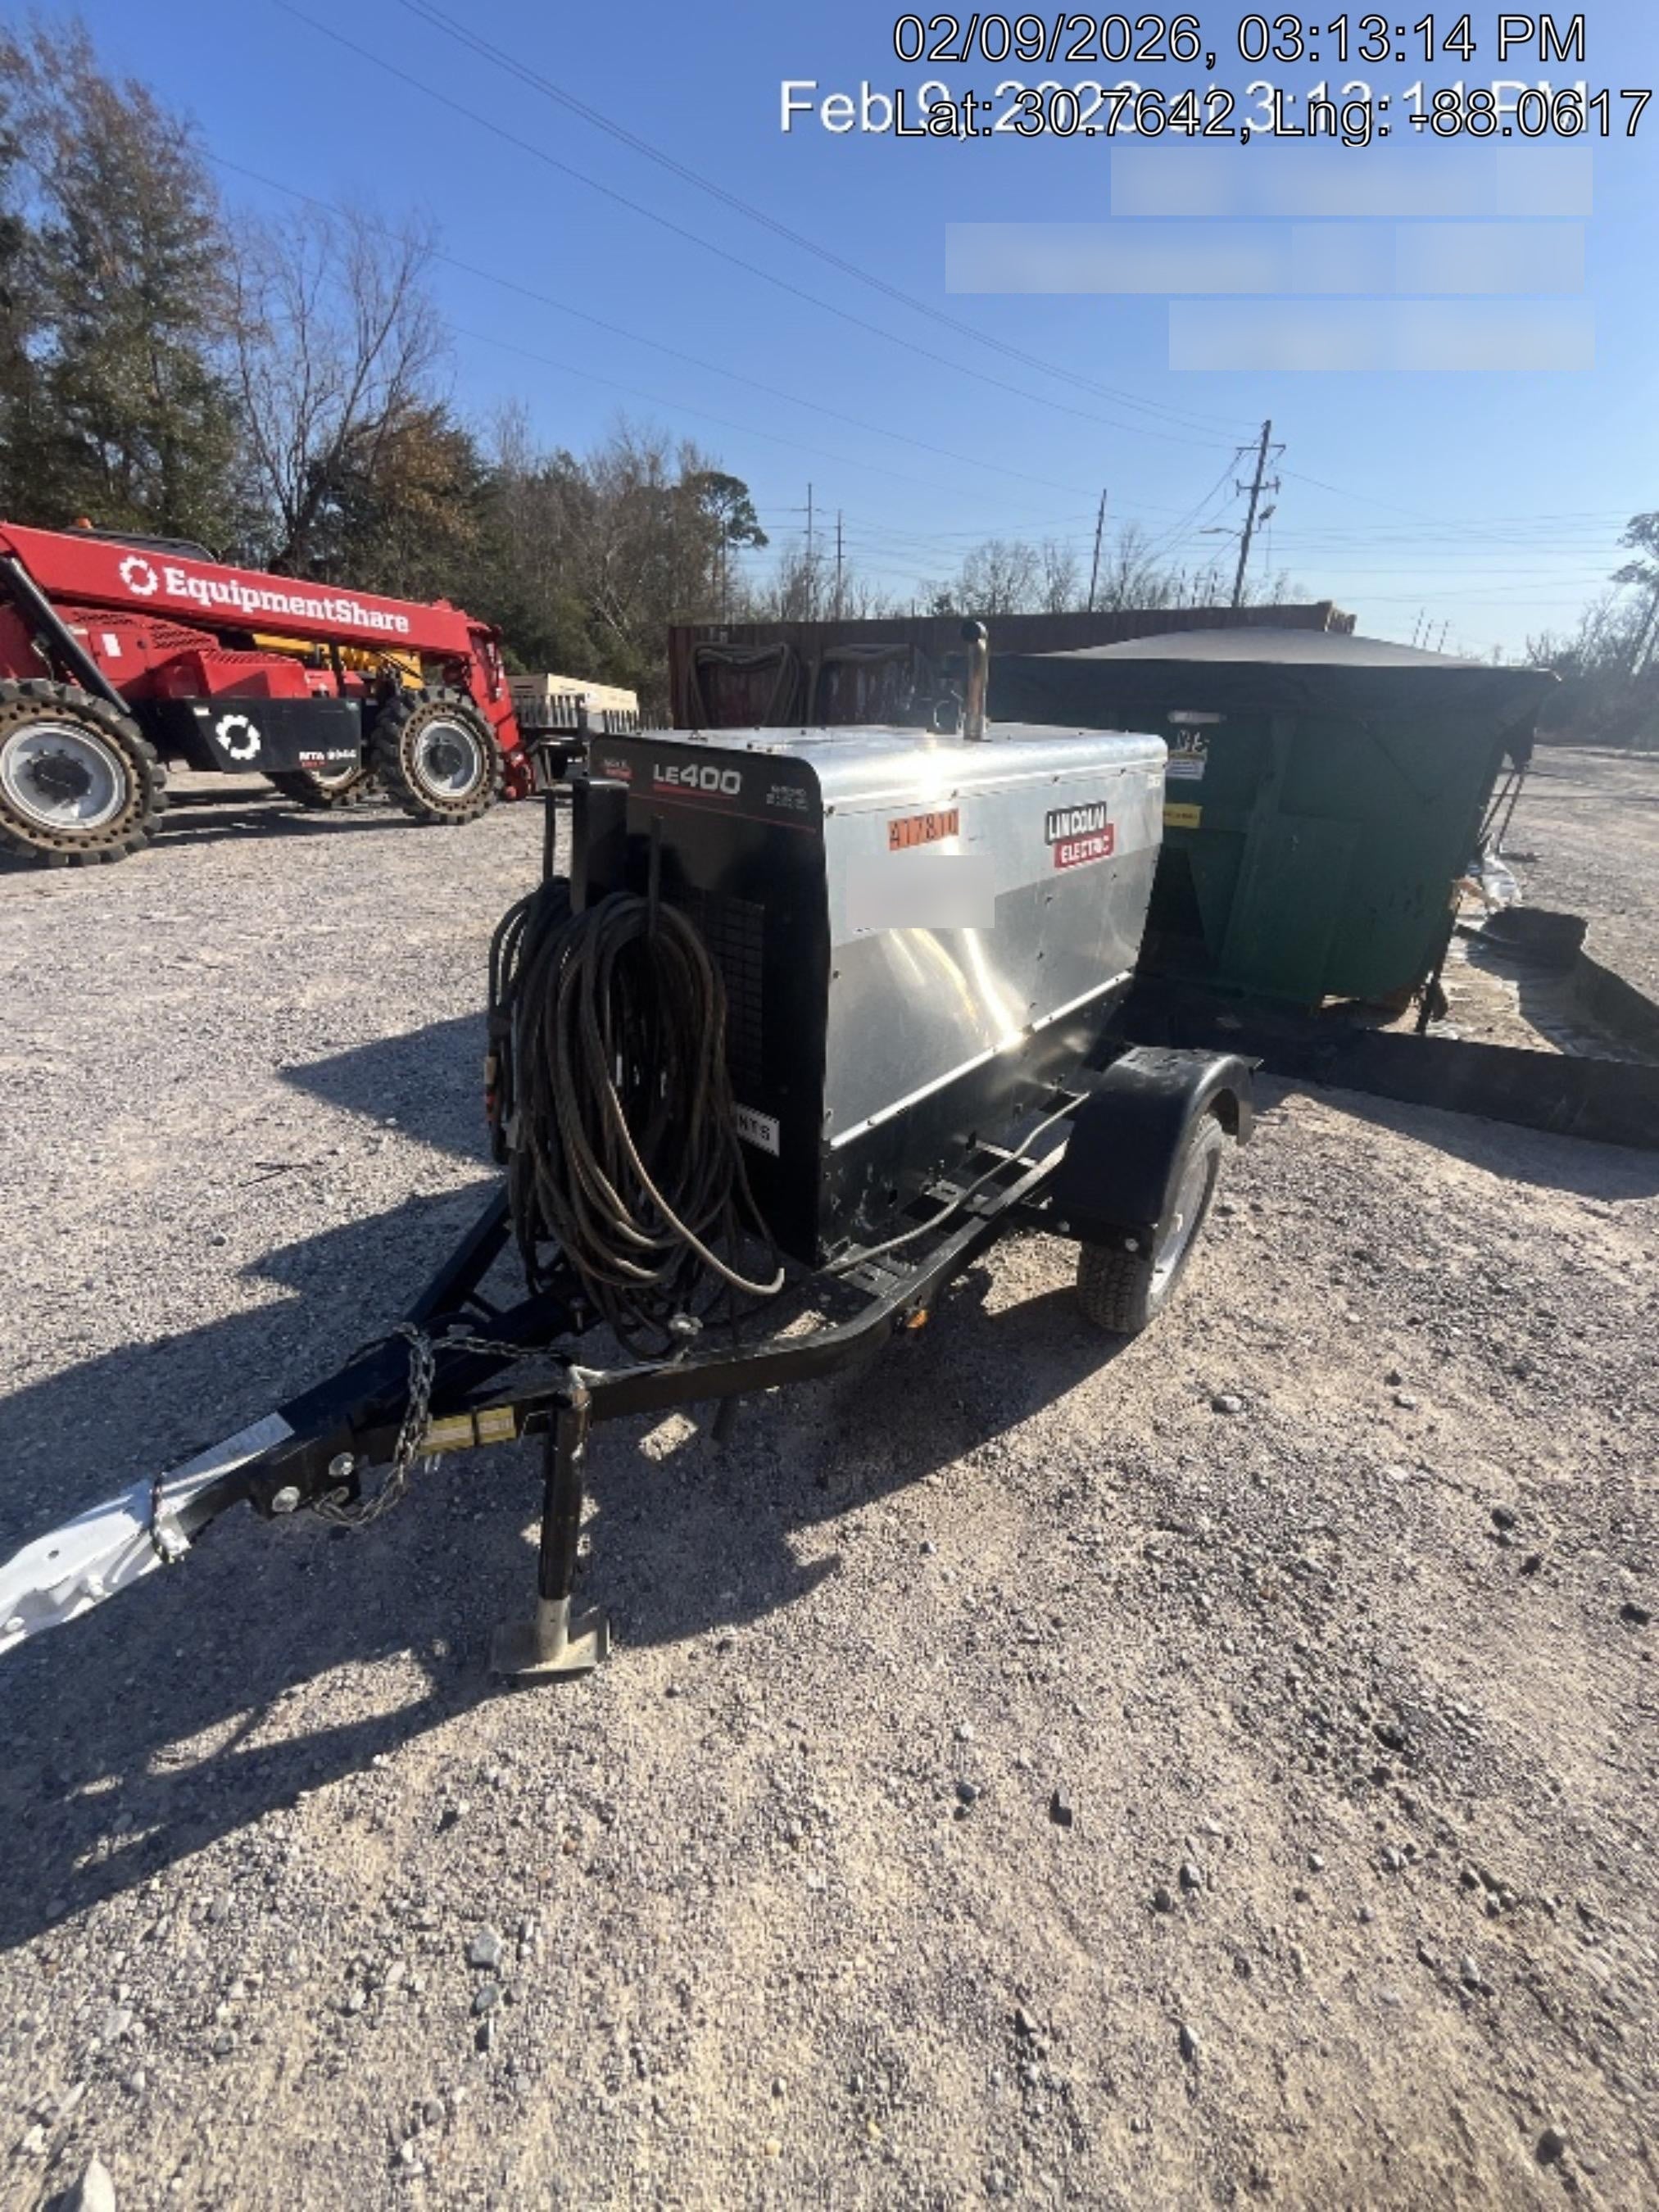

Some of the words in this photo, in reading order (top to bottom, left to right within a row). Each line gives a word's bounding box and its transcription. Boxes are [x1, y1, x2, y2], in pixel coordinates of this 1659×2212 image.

[163, 566, 410, 634] EquipmentShare
[653, 763, 742, 795] LE400
[1049, 805, 1104, 841] LINCOLN
[1060, 834, 1110, 864] ELECTRIC
